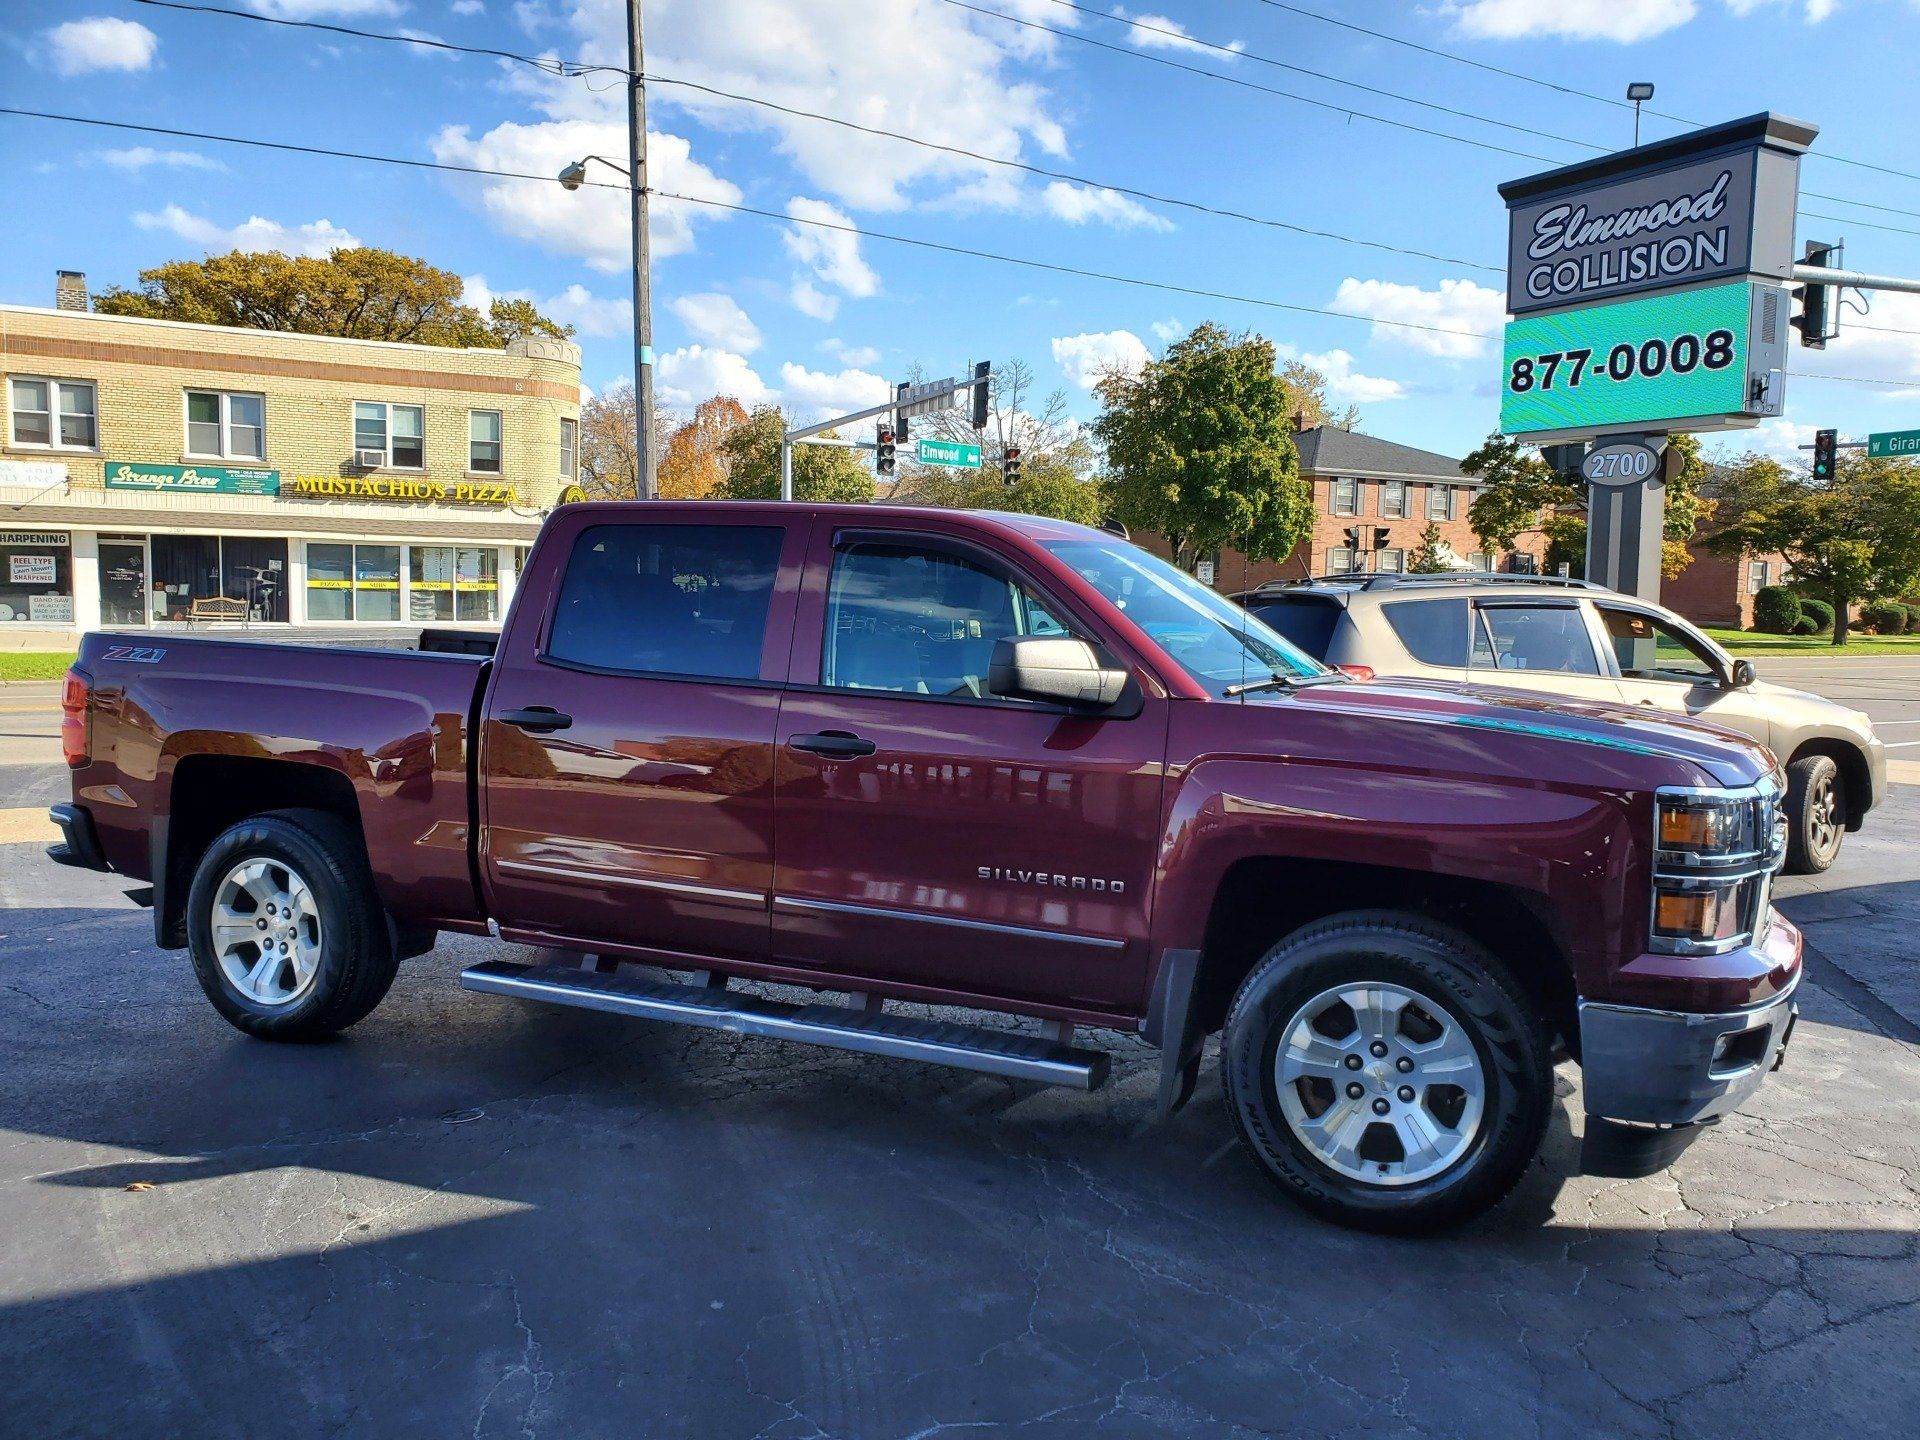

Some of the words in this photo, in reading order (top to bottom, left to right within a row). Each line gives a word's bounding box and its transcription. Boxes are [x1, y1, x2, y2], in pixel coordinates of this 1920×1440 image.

[1528, 171, 1731, 259] Elmwood
[1527, 228, 1728, 297] COLLISION
[1510, 329, 1735, 394] 877-0008
[921, 444, 959, 461] Elmwood
[967, 453, 978, 464] Ave
[1872, 441, 1881, 452] W
[1889, 437, 1920, 451] Girar
[116, 465, 175, 490] Strange
[178, 469, 220, 486] Brew
[1590, 451, 1649, 479] 2700
[296, 475, 446, 499] MUSTACHIO'S
[456, 483, 519, 502] PIZZA
[0, 534, 66, 544] HARPENING
[13, 557, 31, 565] REEL
[101, 645, 168, 664] Z71
[977, 865, 1126, 894] SILVERADO
